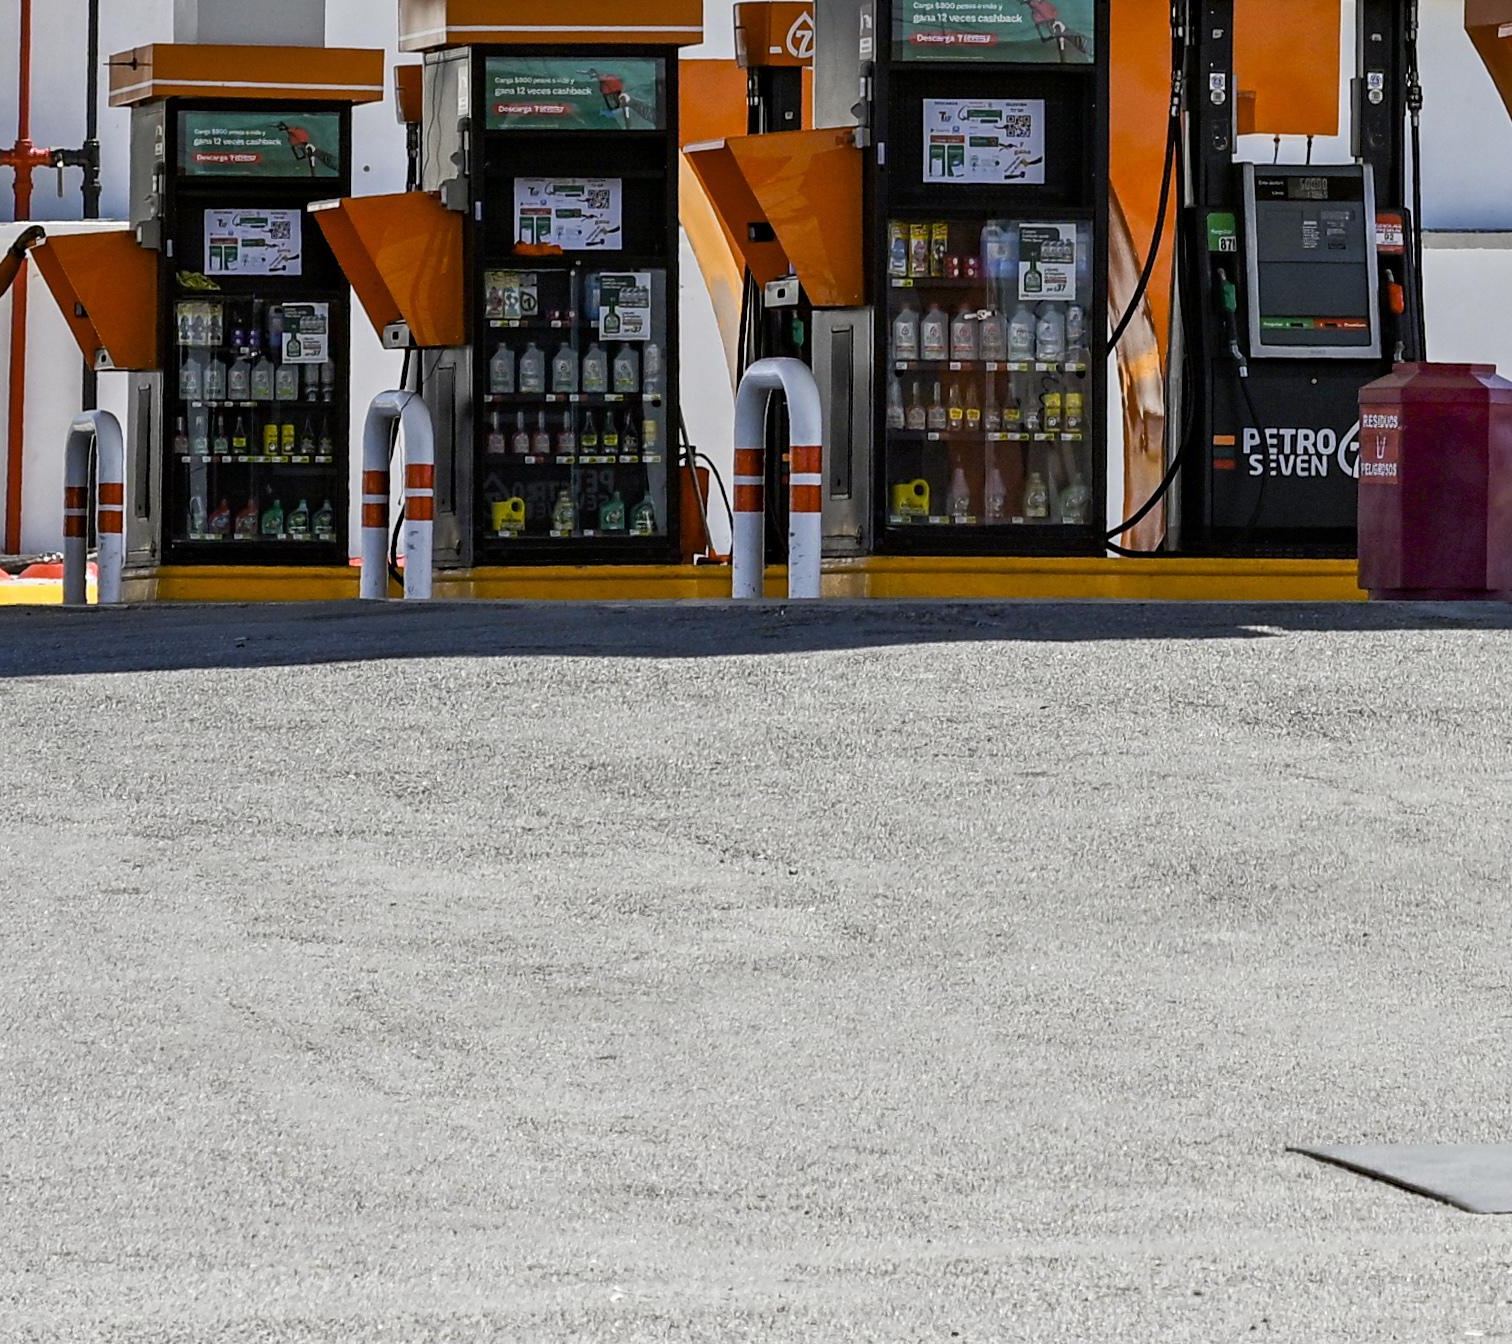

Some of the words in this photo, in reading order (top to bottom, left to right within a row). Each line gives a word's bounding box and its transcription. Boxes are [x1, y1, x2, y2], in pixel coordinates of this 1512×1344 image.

[913, 14, 936, 24] gana
[937, 13, 947, 23] 12
[948, 14, 977, 23] veces
[978, 14, 1023, 23] cashback
[516, 86, 526, 95] 12
[552, 87, 592, 96] cashback
[1362, 414, 1398, 429] RESIDUOS
[1243, 427, 1337, 455] PETRO
[1249, 454, 1328, 477] SEVEN
